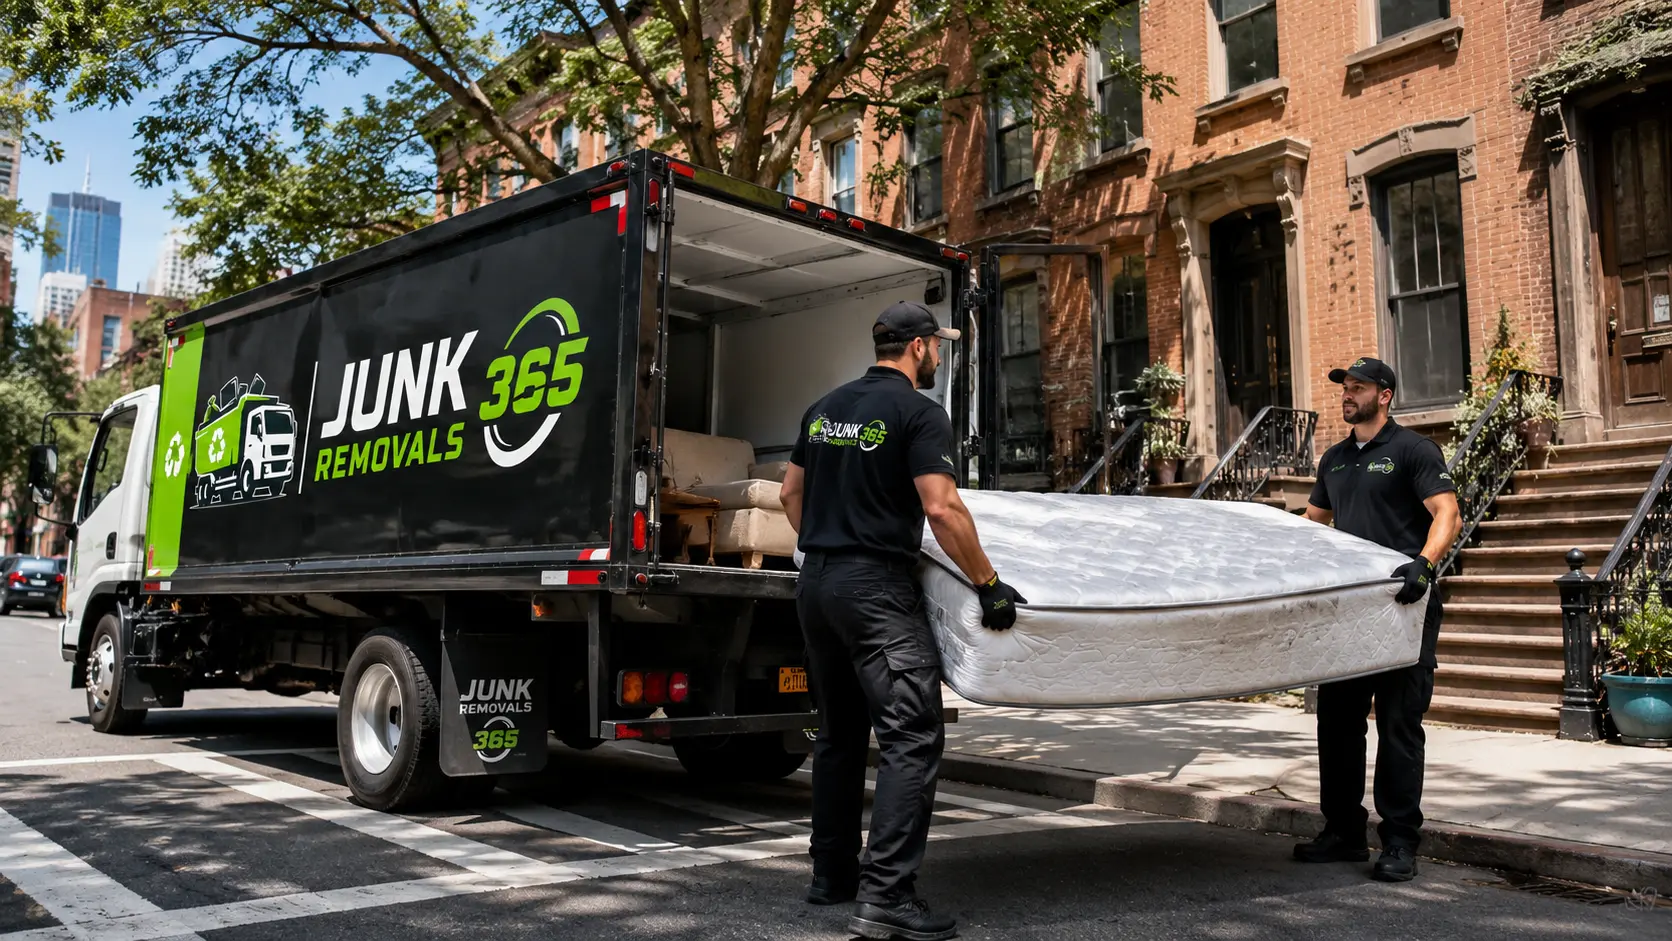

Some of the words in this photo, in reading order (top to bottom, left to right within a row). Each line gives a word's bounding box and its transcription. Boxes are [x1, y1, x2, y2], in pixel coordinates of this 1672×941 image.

[320, 329, 479, 439] JUNK
[478, 336, 590, 421] 365
[859, 426, 888, 445] 365
[314, 421, 466, 482] REMOVALS
[459, 678, 534, 702] JUNK
[459, 702, 532, 715] REMOVALS
[472, 729, 520, 750] 365
